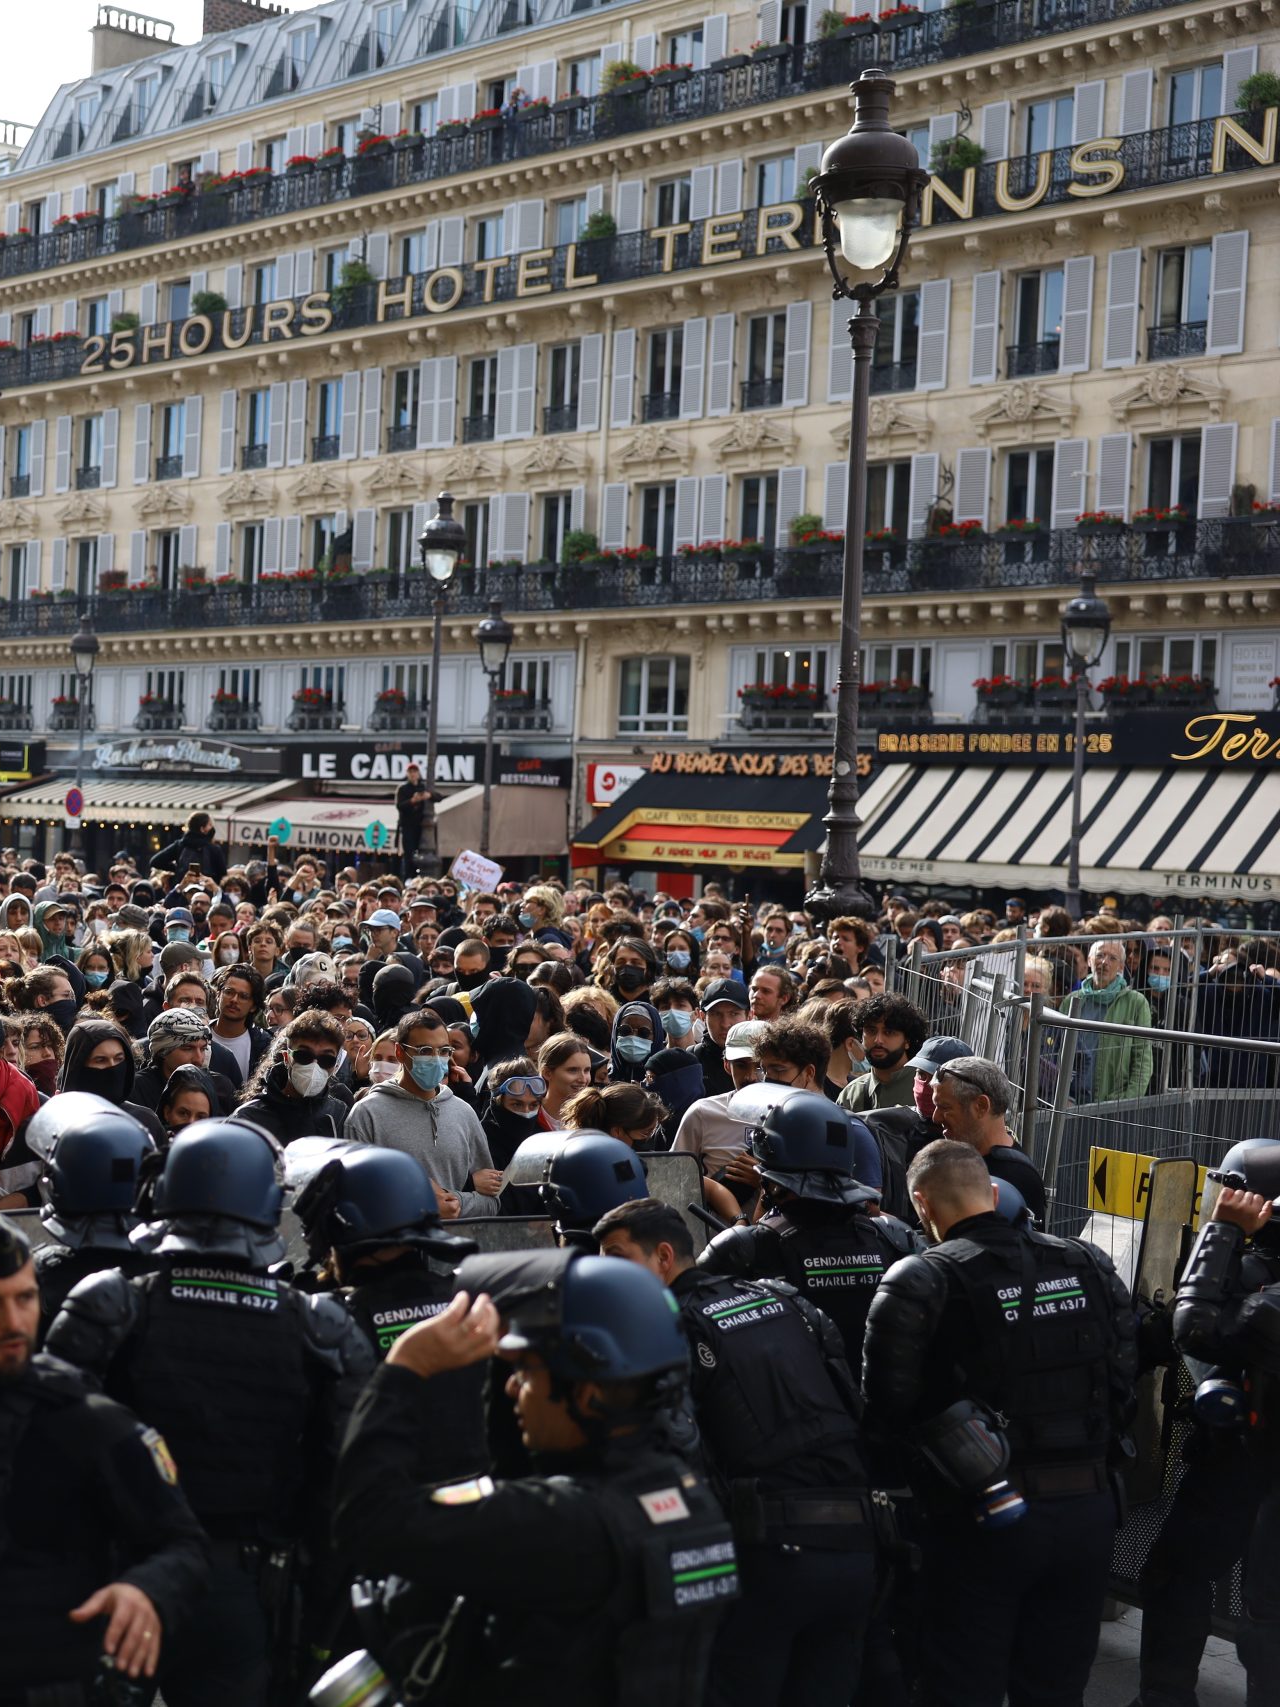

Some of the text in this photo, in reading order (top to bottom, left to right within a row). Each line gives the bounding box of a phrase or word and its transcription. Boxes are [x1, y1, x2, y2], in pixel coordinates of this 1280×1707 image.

[81, 291, 333, 374] 25HOURS
[376, 244, 599, 322] HOTEL
[650, 137, 1125, 272] TERNUS
[878, 733, 965, 753] BRASSERIE
[1036, 733, 1060, 753] EN
[302, 753, 337, 779] LE
[650, 751, 873, 776] AU RENDEZ VOUS DES BEES
[500, 773, 562, 787] RESTAURANT
[676, 811, 699, 823] VINS
[746, 813, 802, 826] COCKTAILS
[297, 831, 392, 850] LIMONAE
[1164, 873, 1273, 891] TERMINUS
[803, 1254, 882, 1268] GENDARMERIE
[171, 1267, 278, 1290] GENDARMERIE
[807, 1275, 857, 1288] CHARLIE
[997, 1276, 1081, 1300] GENRMERIE
[171, 1285, 278, 1310] CHARLIE 43/7
[1059, 1297, 1087, 1311] 43/7
[717, 1302, 785, 1330] CHARLIE 43/7
